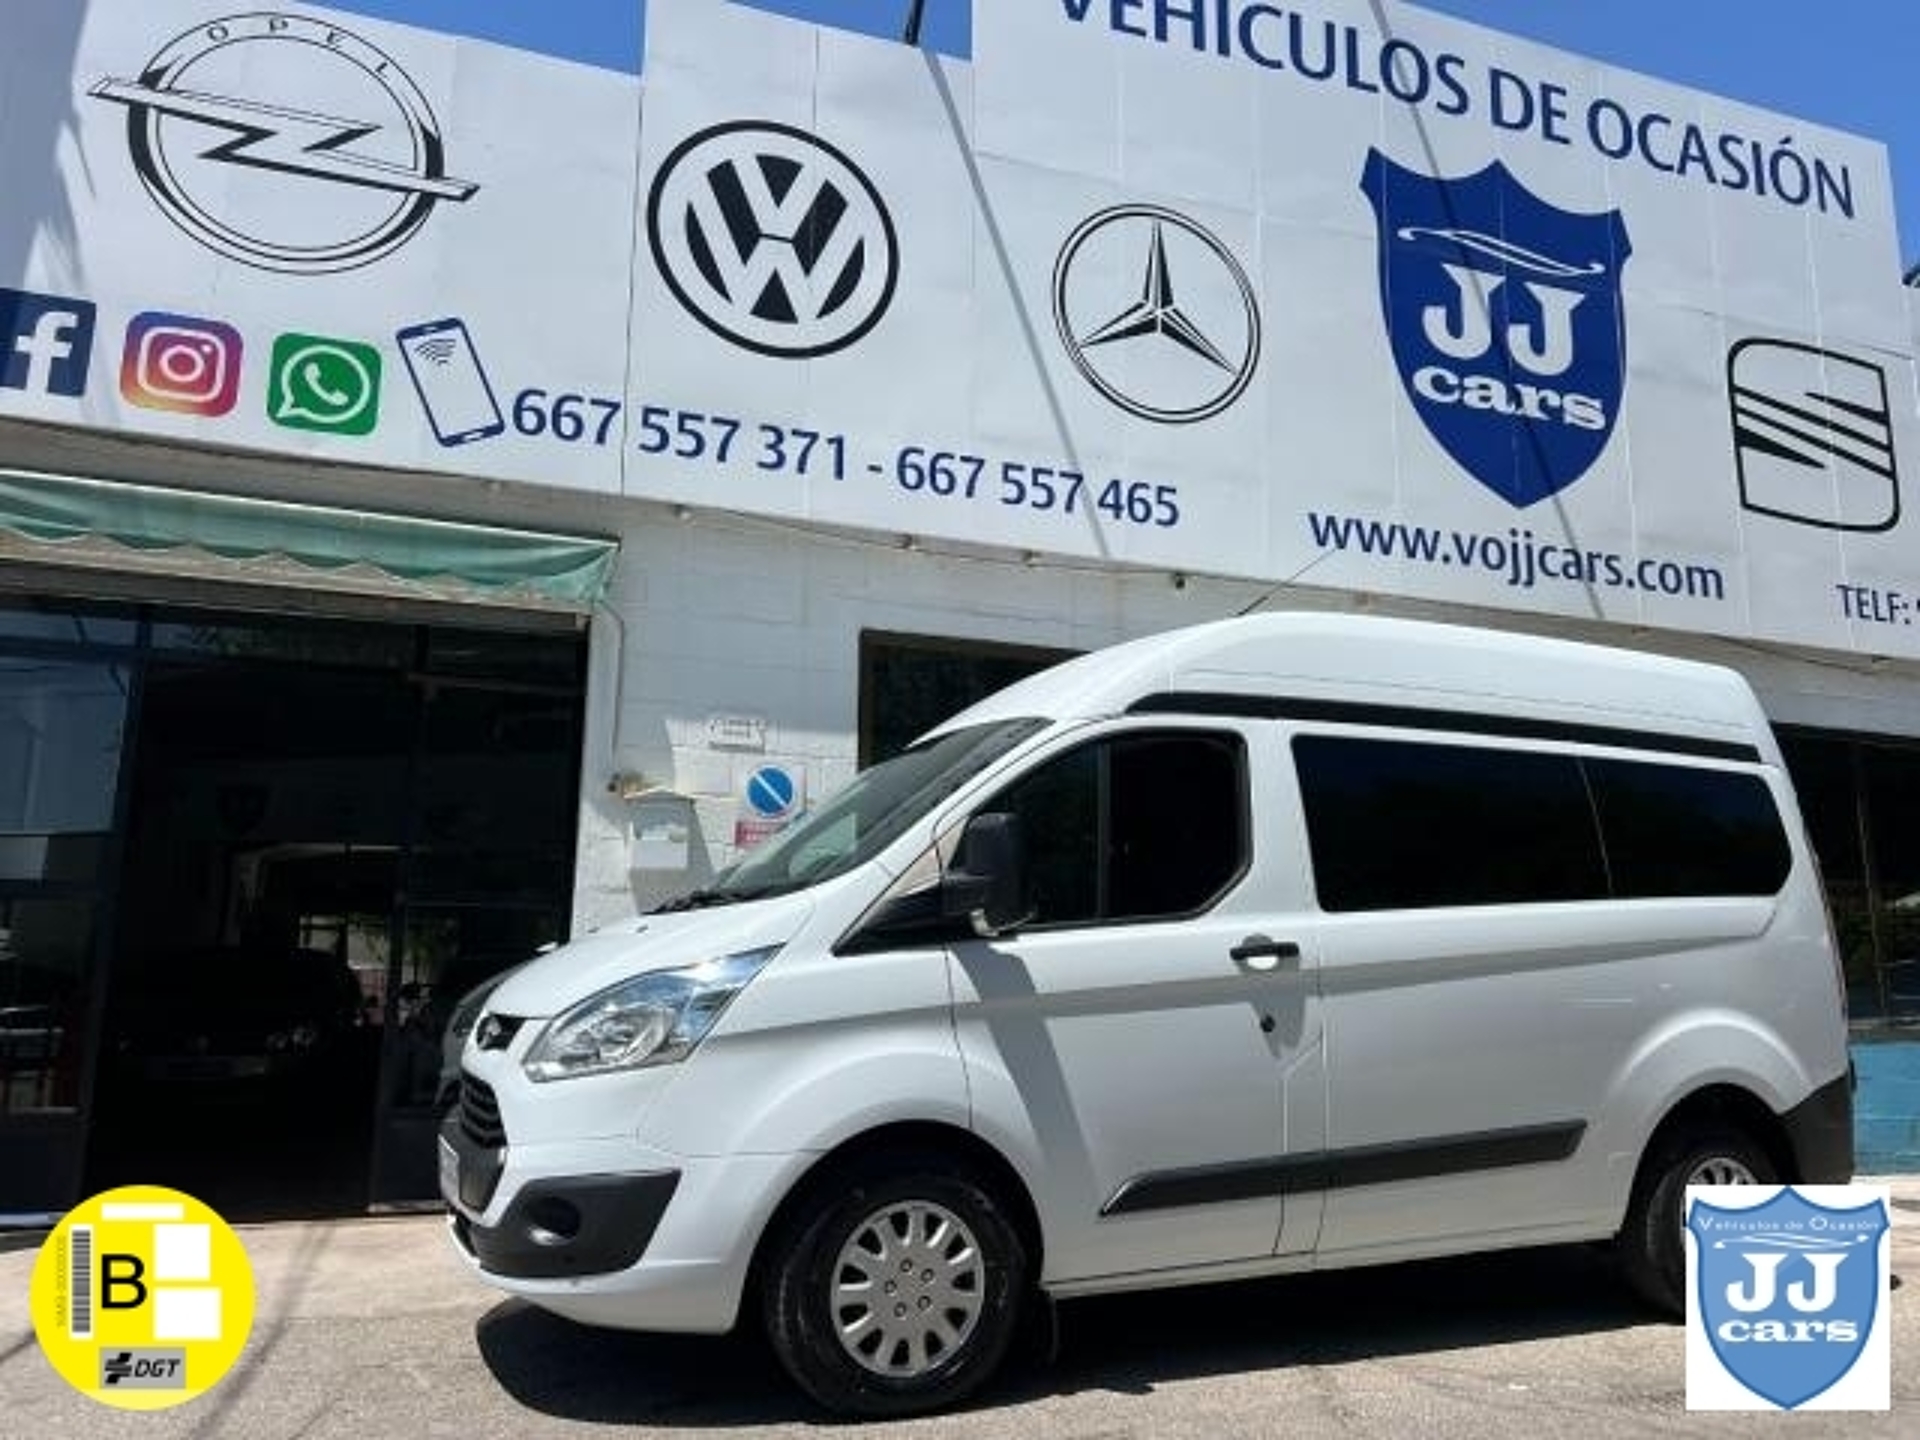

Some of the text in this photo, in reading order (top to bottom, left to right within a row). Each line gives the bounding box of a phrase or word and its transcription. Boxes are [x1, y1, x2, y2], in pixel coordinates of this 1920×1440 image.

[206, 17, 391, 77] OPEL
[1489, 68, 1571, 145] DE
[1587, 98, 1854, 219] OCASIÓN
[1422, 263, 1586, 375] JJ
[1413, 366, 1606, 431] cars
[512, 388, 622, 445] 667
[639, 406, 741, 463] 557
[757, 424, 844, 481] 371
[897, 447, 985, 498] 667
[1001, 462, 1084, 513] 557
[1097, 479, 1180, 527] 465
[1308, 511, 1724, 602] www.vojjcars.com
[1835, 584, 1912, 626] TELF:
